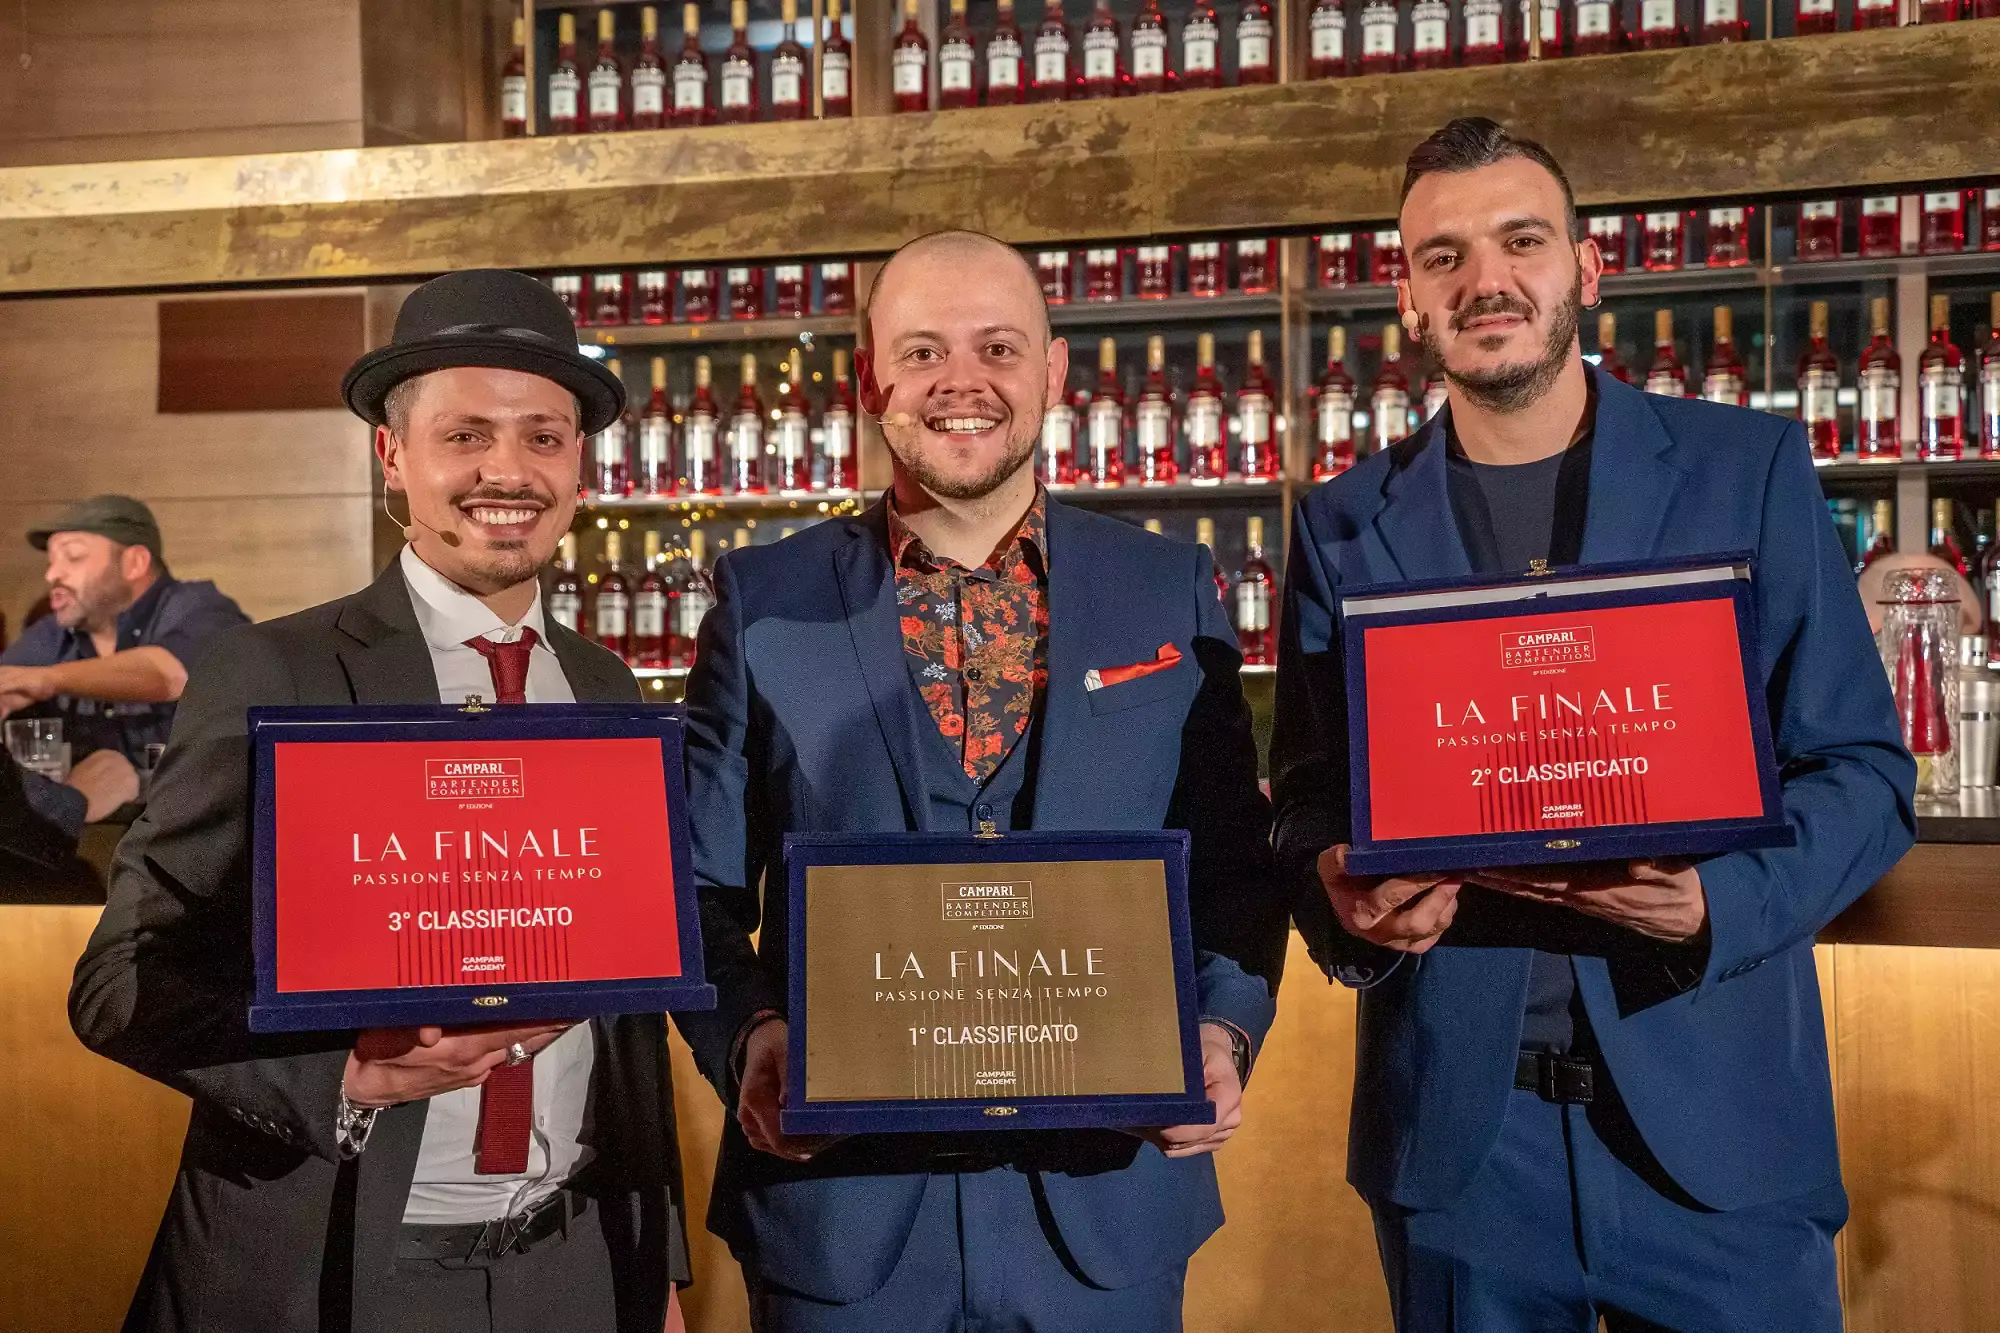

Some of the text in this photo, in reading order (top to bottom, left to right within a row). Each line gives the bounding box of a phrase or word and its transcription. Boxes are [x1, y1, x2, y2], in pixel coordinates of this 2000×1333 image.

[1505, 644, 1590, 659] BARTENDER
[1506, 652, 1591, 666] COMPETITION
[1436, 683, 1674, 728] LA FINALE
[1437, 719, 1677, 748] PASSIONE SENZA TEMPO
[1471, 756, 1649, 786] 2° CLASSIFICATO
[430, 779, 520, 789] BARTENDER
[430, 787, 520, 796] COMPETITION
[1541, 810, 1585, 819] ACADEMY
[1542, 803, 1582, 812] CAMPARI
[353, 827, 600, 862] LA FINALE
[353, 867, 602, 886] PASSIONE SENZA TEMPO
[946, 901, 1029, 910] BARTENDER
[388, 906, 573, 931] 3° CLASSIFICATO
[946, 909, 1029, 917] COMPETITION
[462, 956, 504, 964] CAMPARI
[875, 947, 1106, 979] LA FINALE
[461, 963, 506, 972] ACADEMY
[875, 986, 1108, 1002] PASSIONE SENZA TEMPO
[908, 1023, 1079, 1046] 1° CLASSIFICATO
[976, 1070, 1016, 1078] CAMPARI
